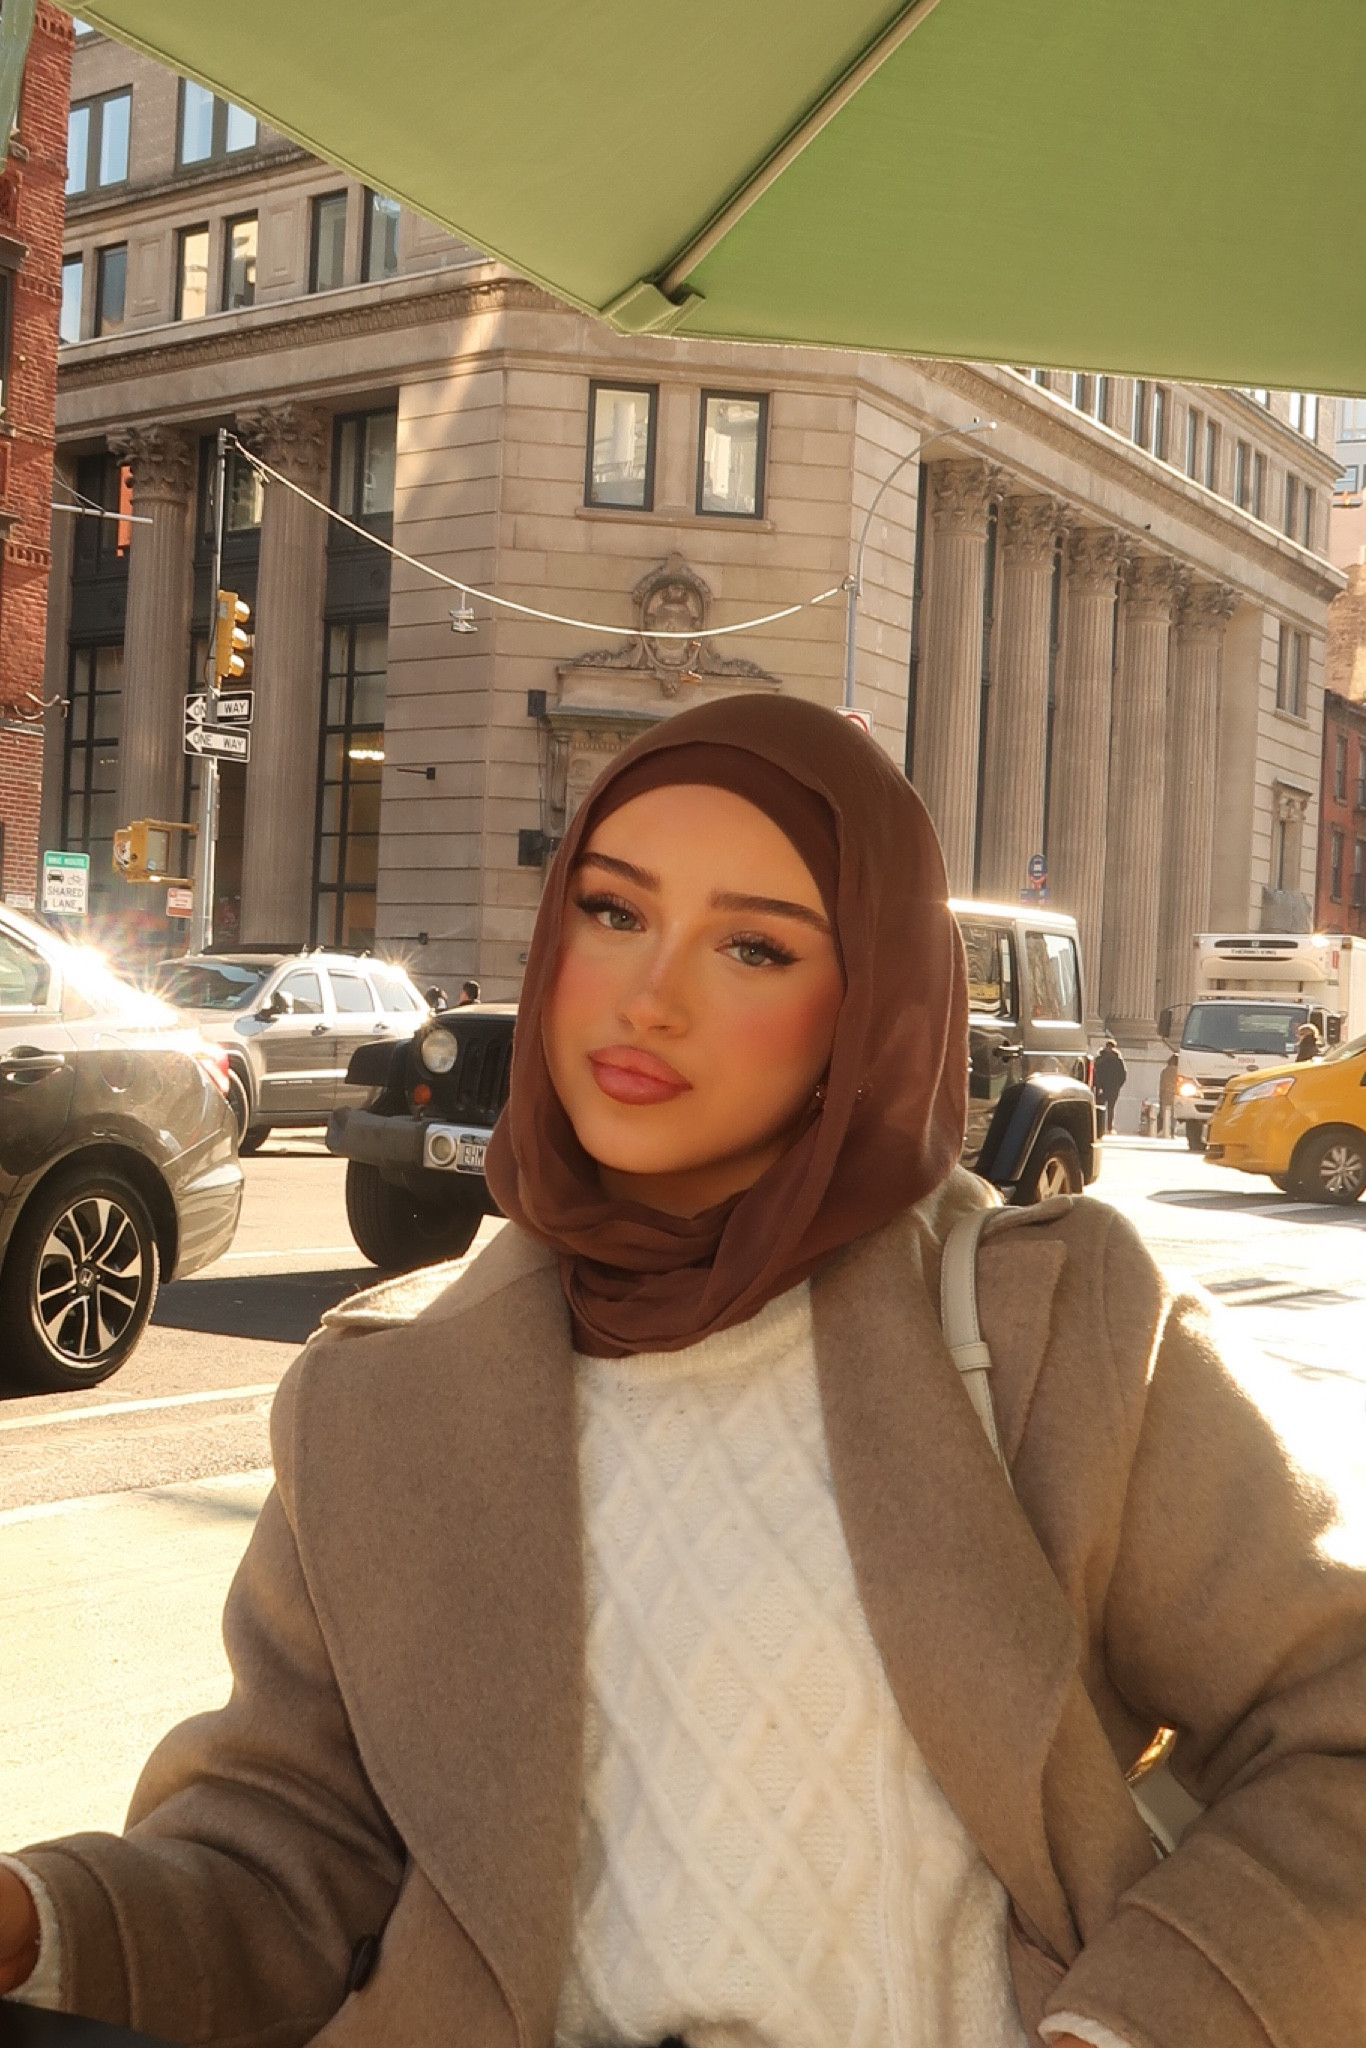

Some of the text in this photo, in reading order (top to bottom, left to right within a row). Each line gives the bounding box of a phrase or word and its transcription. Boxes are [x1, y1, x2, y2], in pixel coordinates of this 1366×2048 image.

[193, 702, 246, 716] ON WAY
[193, 732, 243, 749] ONE WAY
[47, 886, 84, 898] SHARED
[53, 898, 77, 910] LANE
